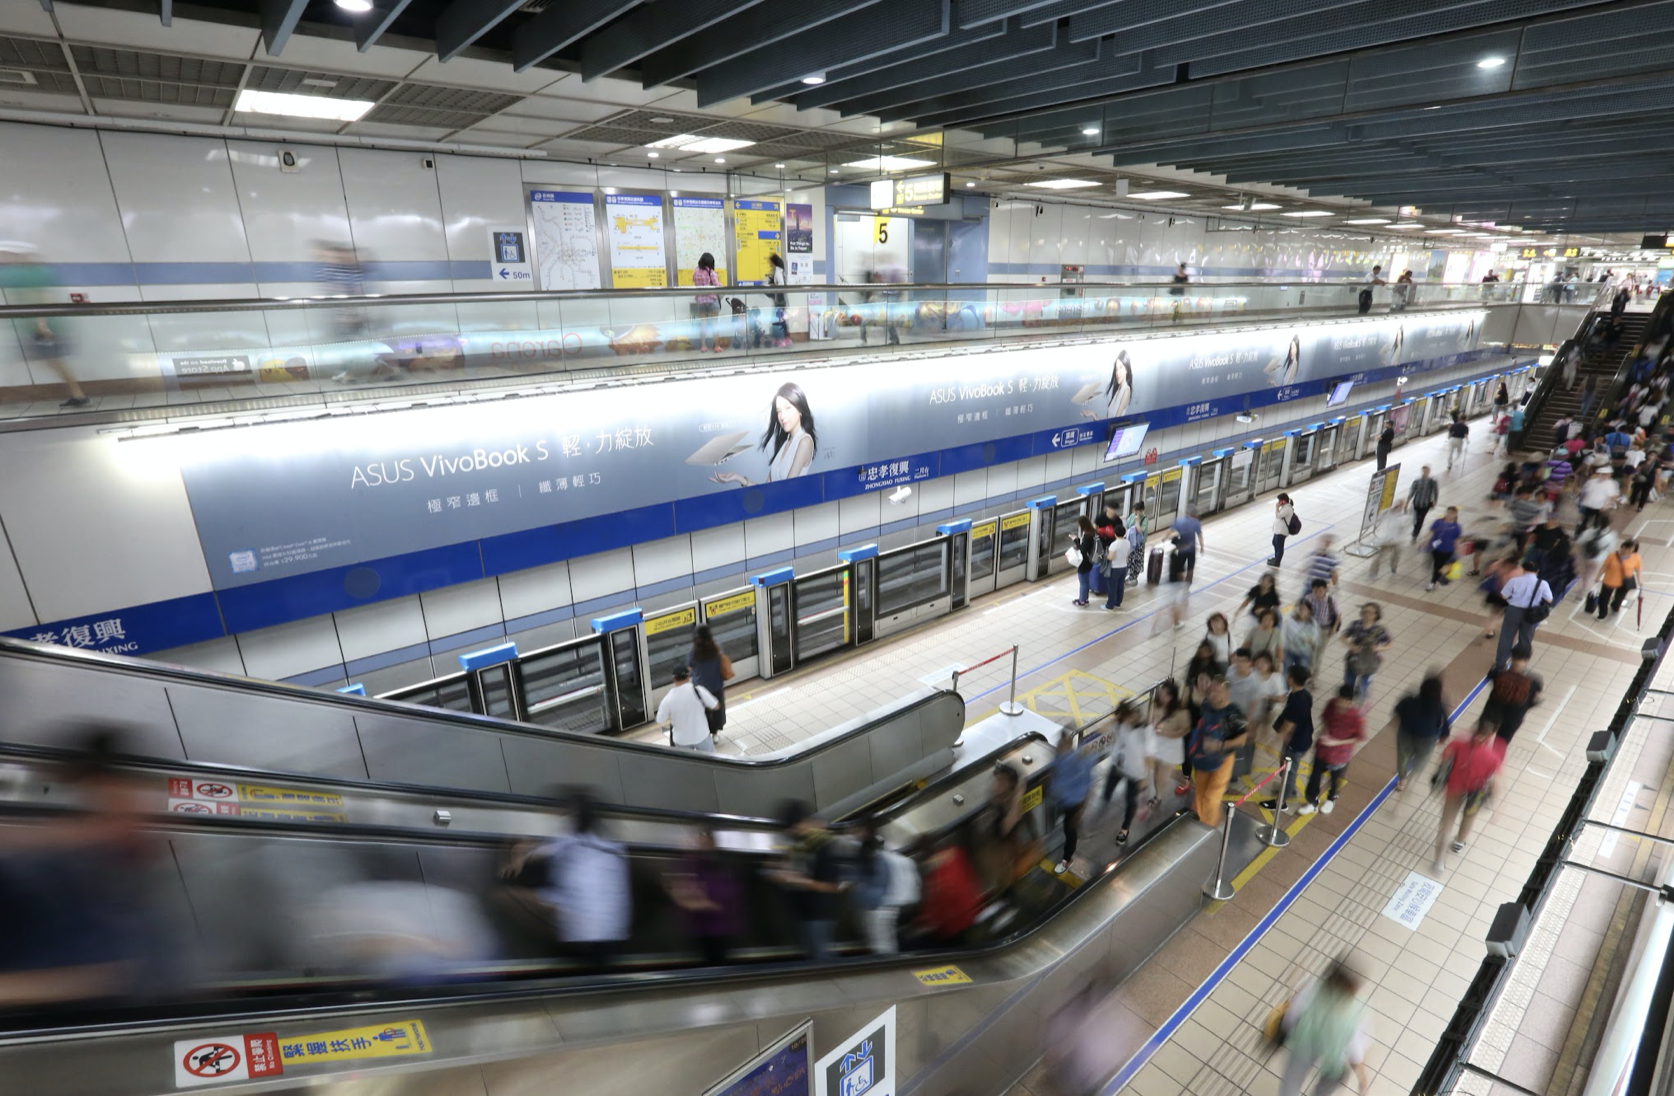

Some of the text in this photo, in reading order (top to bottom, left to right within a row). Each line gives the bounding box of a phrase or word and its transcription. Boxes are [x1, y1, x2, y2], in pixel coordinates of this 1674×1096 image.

[904, 184, 913, 201] 5
[879, 223, 888, 244] 5
[512, 271, 531, 279] 50m
[929, 380, 1014, 405] ASUS VivoBook S
[351, 439, 549, 490] ASUS VivoBook S
[867, 461, 909, 481] 忠孝復興
[538, 471, 601, 495] 纖薄輕巧
[865, 479, 893, 490] ZHONGXIAO
[894, 474, 912, 484] FUXING
[427, 488, 500, 514] 極窄邊框
[265, 1039, 276, 1069] No Climbing
[282, 1036, 373, 1059] 緊握扶手
